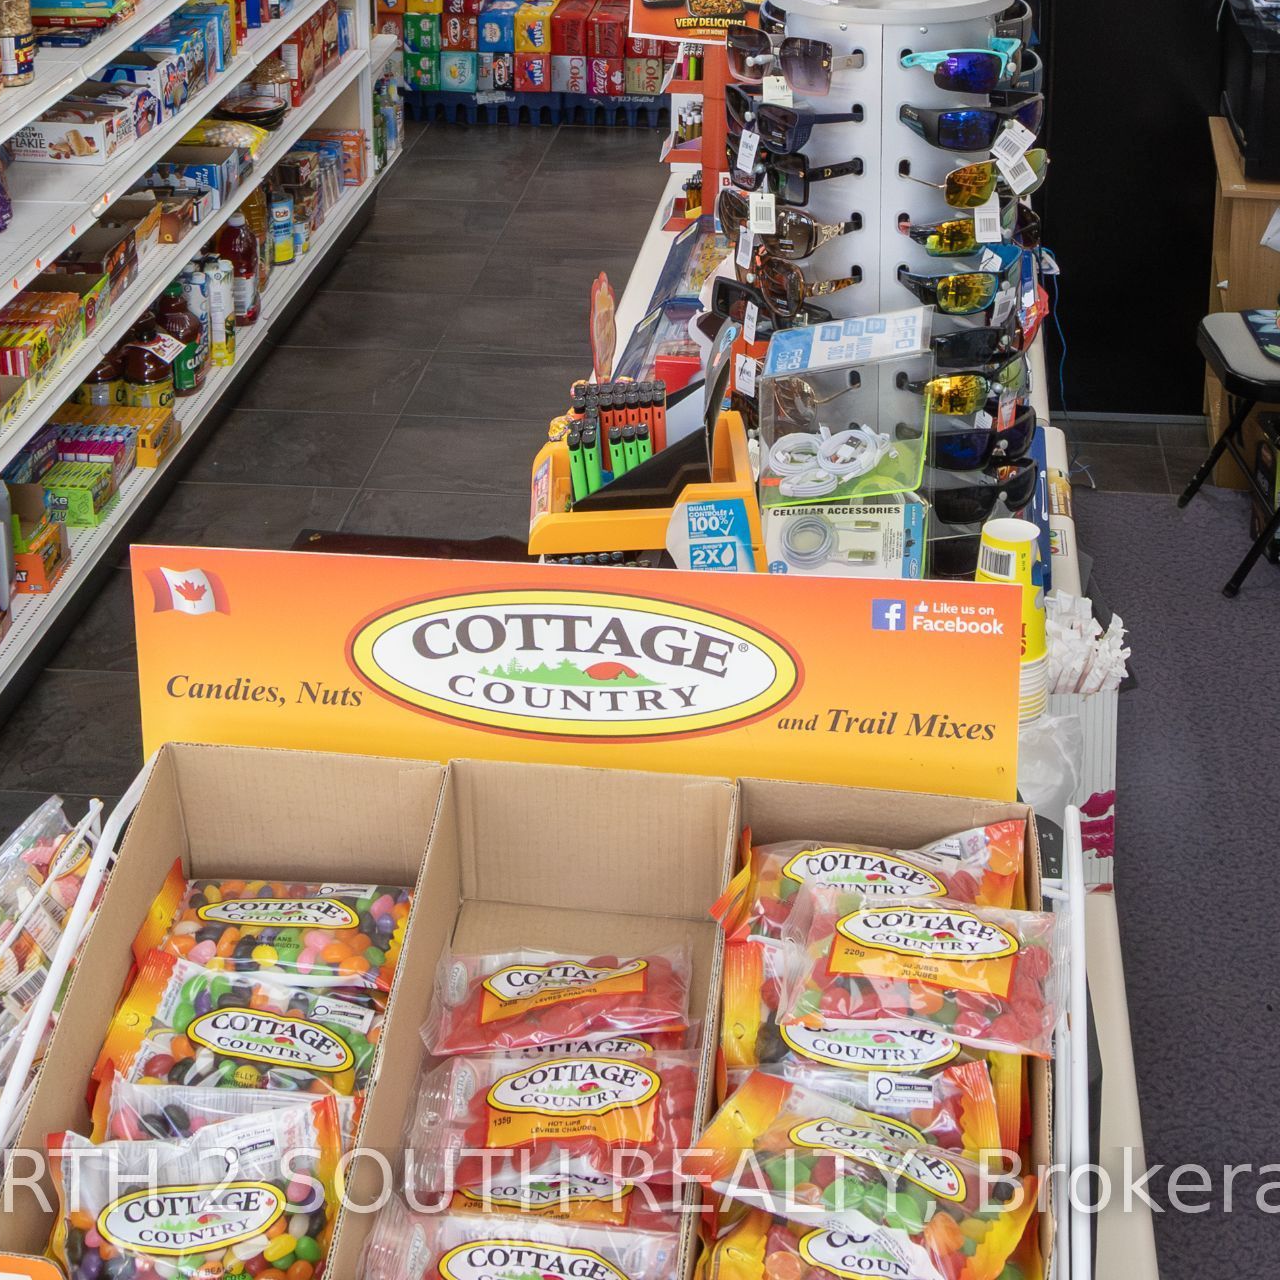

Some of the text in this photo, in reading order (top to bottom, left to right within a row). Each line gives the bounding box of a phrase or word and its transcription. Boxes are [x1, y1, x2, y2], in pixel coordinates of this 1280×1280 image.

[675, 18, 703, 28] VERY
[569, 57, 584, 93] Coke
[645, 58, 657, 93] Coke
[688, 504, 715, 513] QUALITÉ
[772, 506, 901, 517] CELLULAR ACCESSORIES
[692, 551, 720, 565] 2X
[931, 600, 996, 617] Like us on
[912, 613, 1006, 637] Facebook
[410, 613, 738, 679] COTTAGE
[166, 674, 365, 708] Candies, Nuts
[447, 672, 702, 714] COUNTRY
[777, 710, 996, 743] and Trail Mixes
[805, 851, 929, 886] COTTAGE
[219, 899, 344, 926] COTTAGE
[227, 909, 325, 924] COUNTRY
[861, 910, 998, 942] COTTAGE
[843, 946, 866, 958] 220g
[870, 931, 981, 952] COUNTRY
[210, 1012, 340, 1056] COTTAGE
[215, 1036, 317, 1063] COUNTRY
[812, 1038, 923, 1063] COUNTRY
[509, 1064, 639, 1091] COTTAGE
[520, 1089, 622, 1107] COUNTRY
[489, 1184, 596, 1201] COUNTRY
[123, 1191, 261, 1223] COTTAGE
[137, 1218, 249, 1245] COUNTRY
[466, 1247, 614, 1280] COTTAGE
